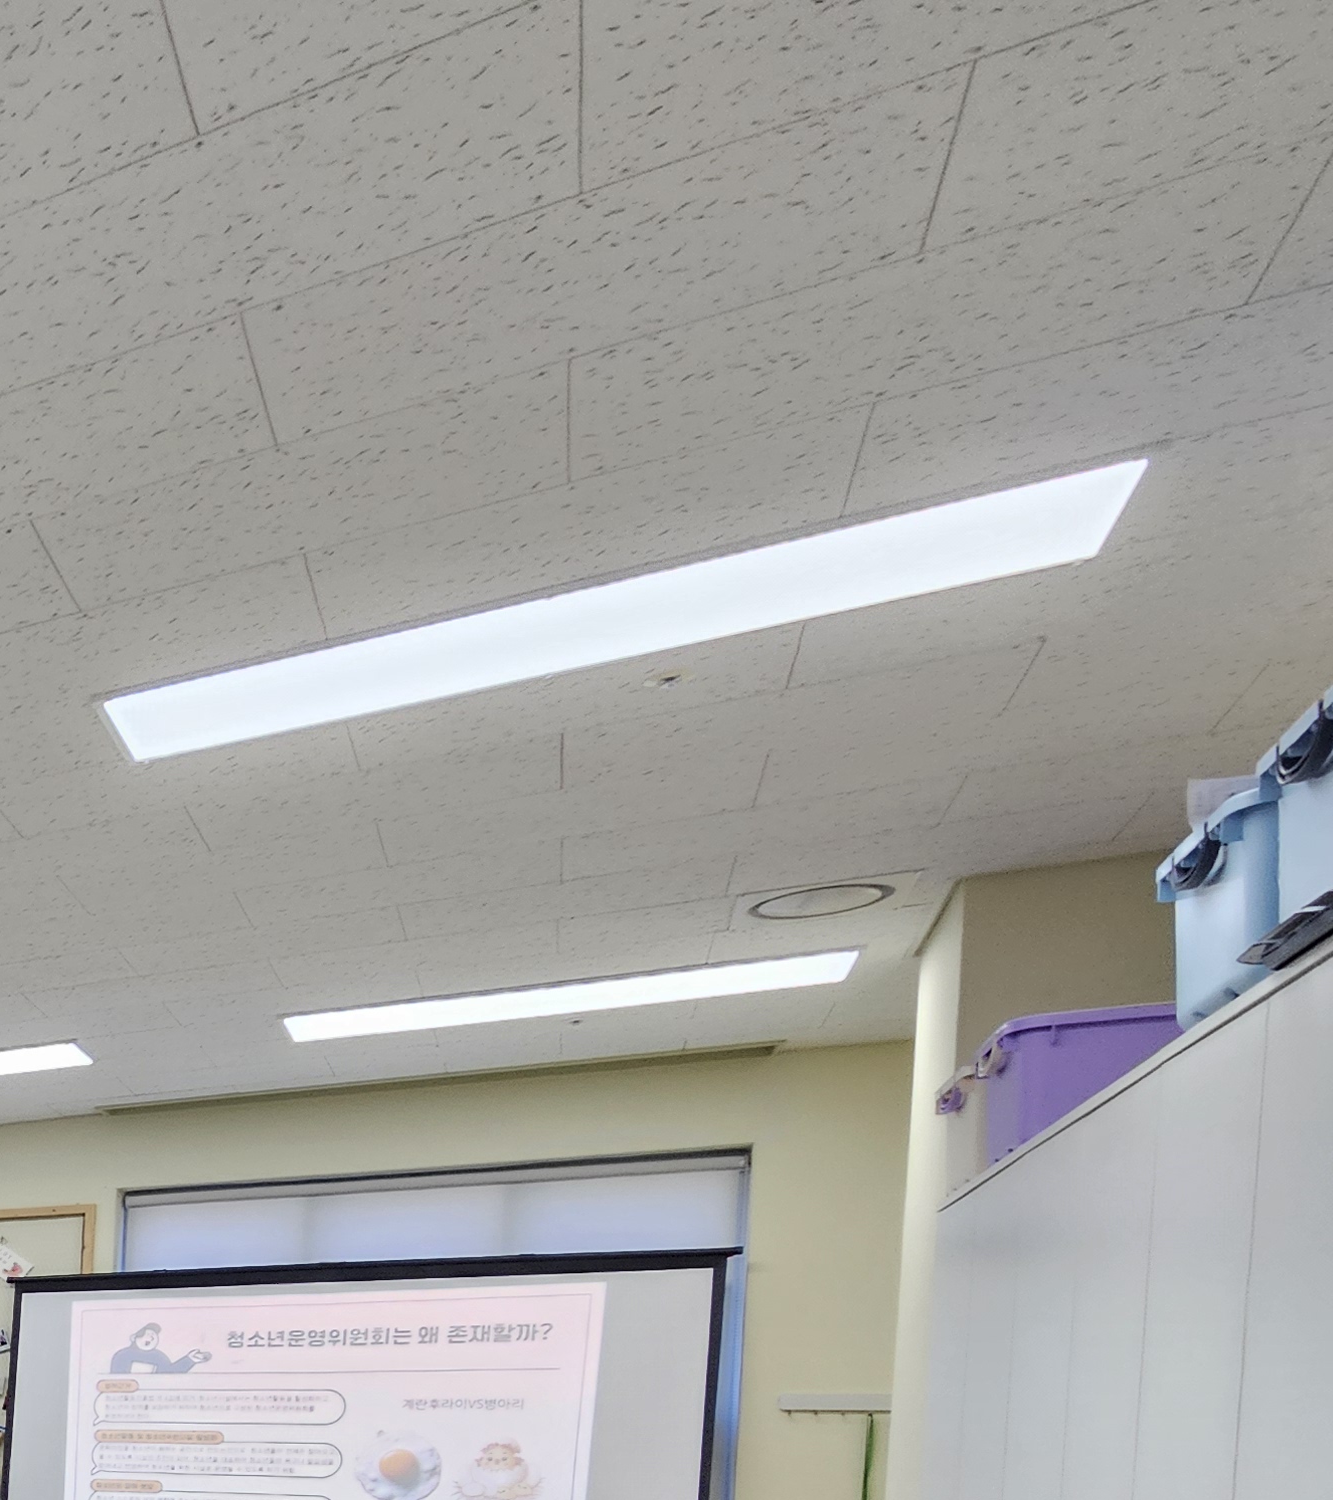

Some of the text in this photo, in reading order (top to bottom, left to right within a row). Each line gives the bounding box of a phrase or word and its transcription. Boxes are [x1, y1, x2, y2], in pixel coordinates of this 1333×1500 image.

[226, 1322, 554, 1349] 청소년운영위원회는 왜 존재할까?
